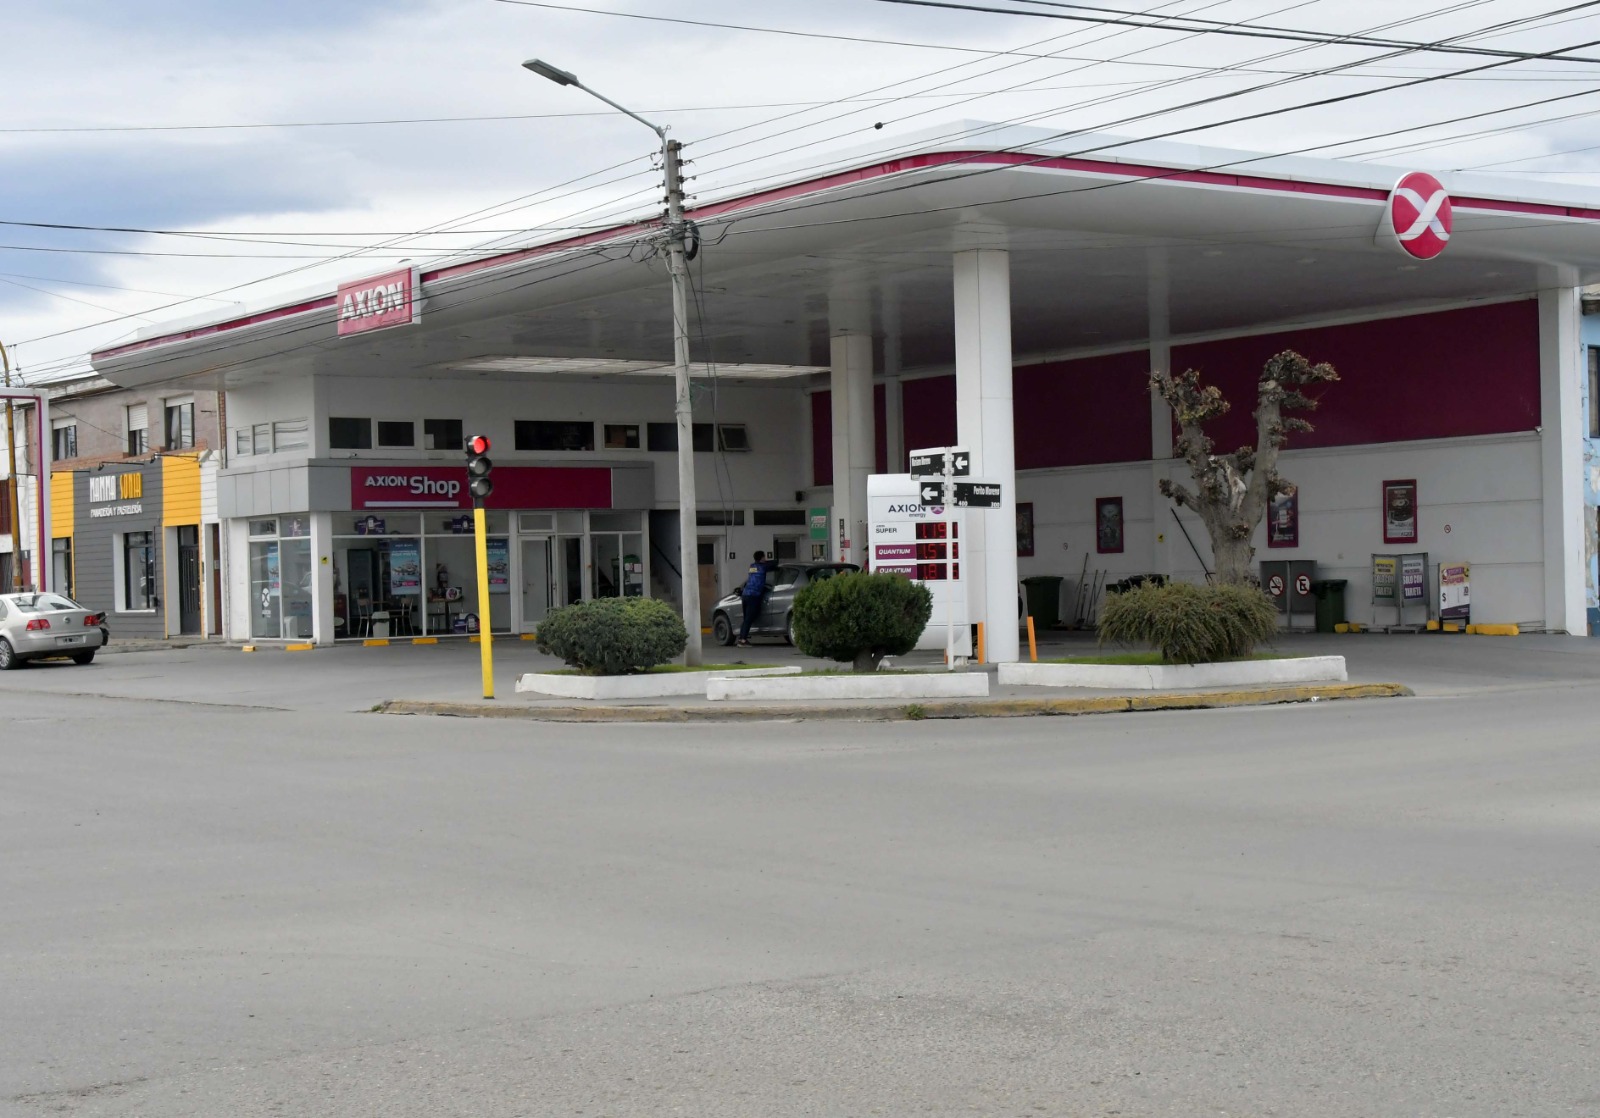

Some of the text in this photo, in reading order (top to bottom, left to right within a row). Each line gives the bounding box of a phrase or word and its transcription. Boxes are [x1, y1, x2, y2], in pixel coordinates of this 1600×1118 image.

[341, 281, 404, 322] AXION
[90, 475, 116, 502] MAMMA
[365, 476, 460, 498] AXION Shop
[888, 504, 926, 513] AXION
[1403, 575, 1413, 584] SOLO
